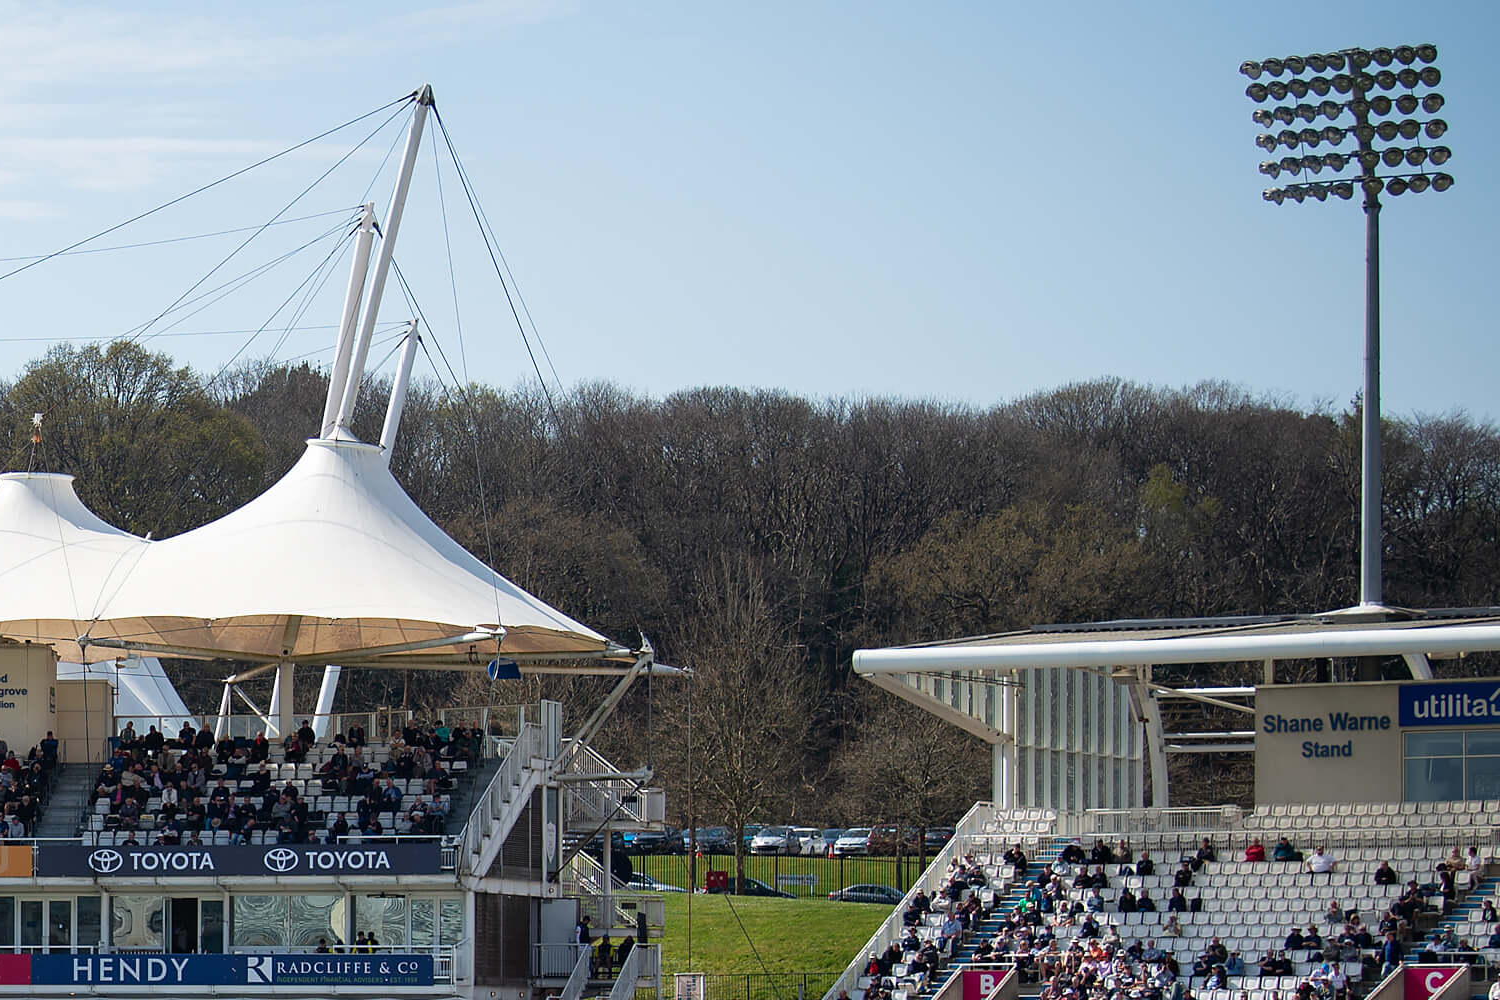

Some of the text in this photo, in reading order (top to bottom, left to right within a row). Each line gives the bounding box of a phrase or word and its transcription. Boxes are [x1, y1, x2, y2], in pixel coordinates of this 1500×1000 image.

[1413, 693, 1488, 719] utilita
[1263, 712, 1391, 734] Shane Warne
[1301, 740, 1353, 759] Stand
[129, 852, 215, 870] TOYOTA
[305, 851, 391, 869] TOYOTA
[73, 958, 189, 982] HENDY
[276, 961, 372, 974] RADCLIFFE
[379, 961, 391, 974] &
[980, 974, 995, 995] B
[1424, 971, 1444, 994] C
